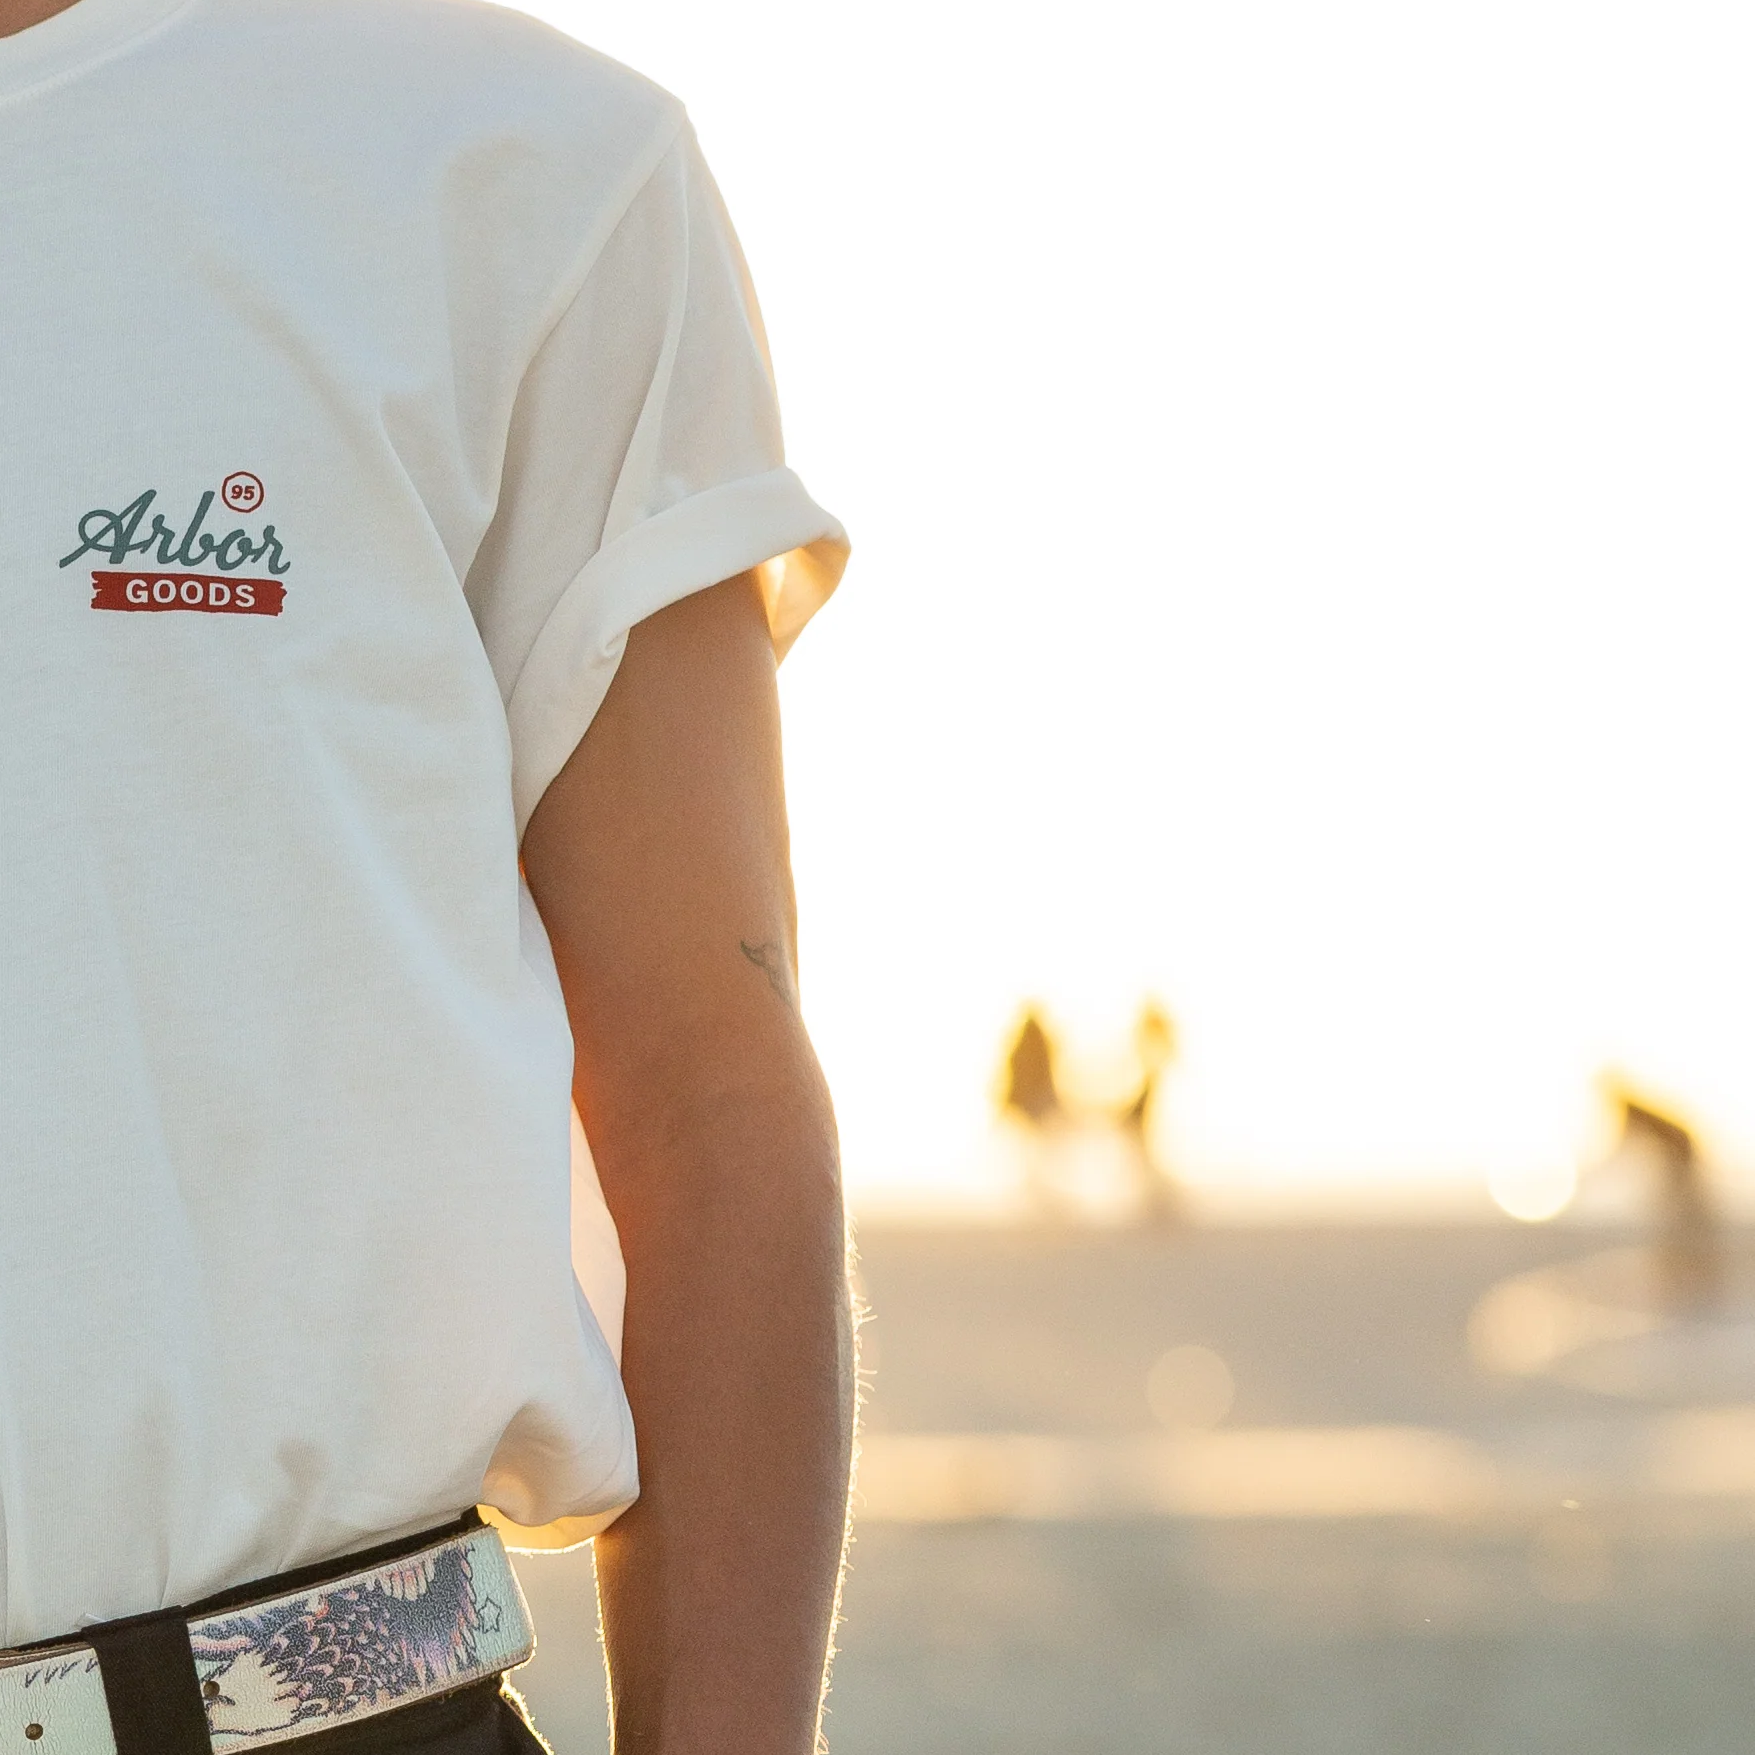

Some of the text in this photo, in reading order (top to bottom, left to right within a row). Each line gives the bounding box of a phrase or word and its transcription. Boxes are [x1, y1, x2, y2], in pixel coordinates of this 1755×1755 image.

[230, 484, 255, 501] 95
[59, 489, 291, 575] Arbor
[125, 579, 256, 607] GOODS
